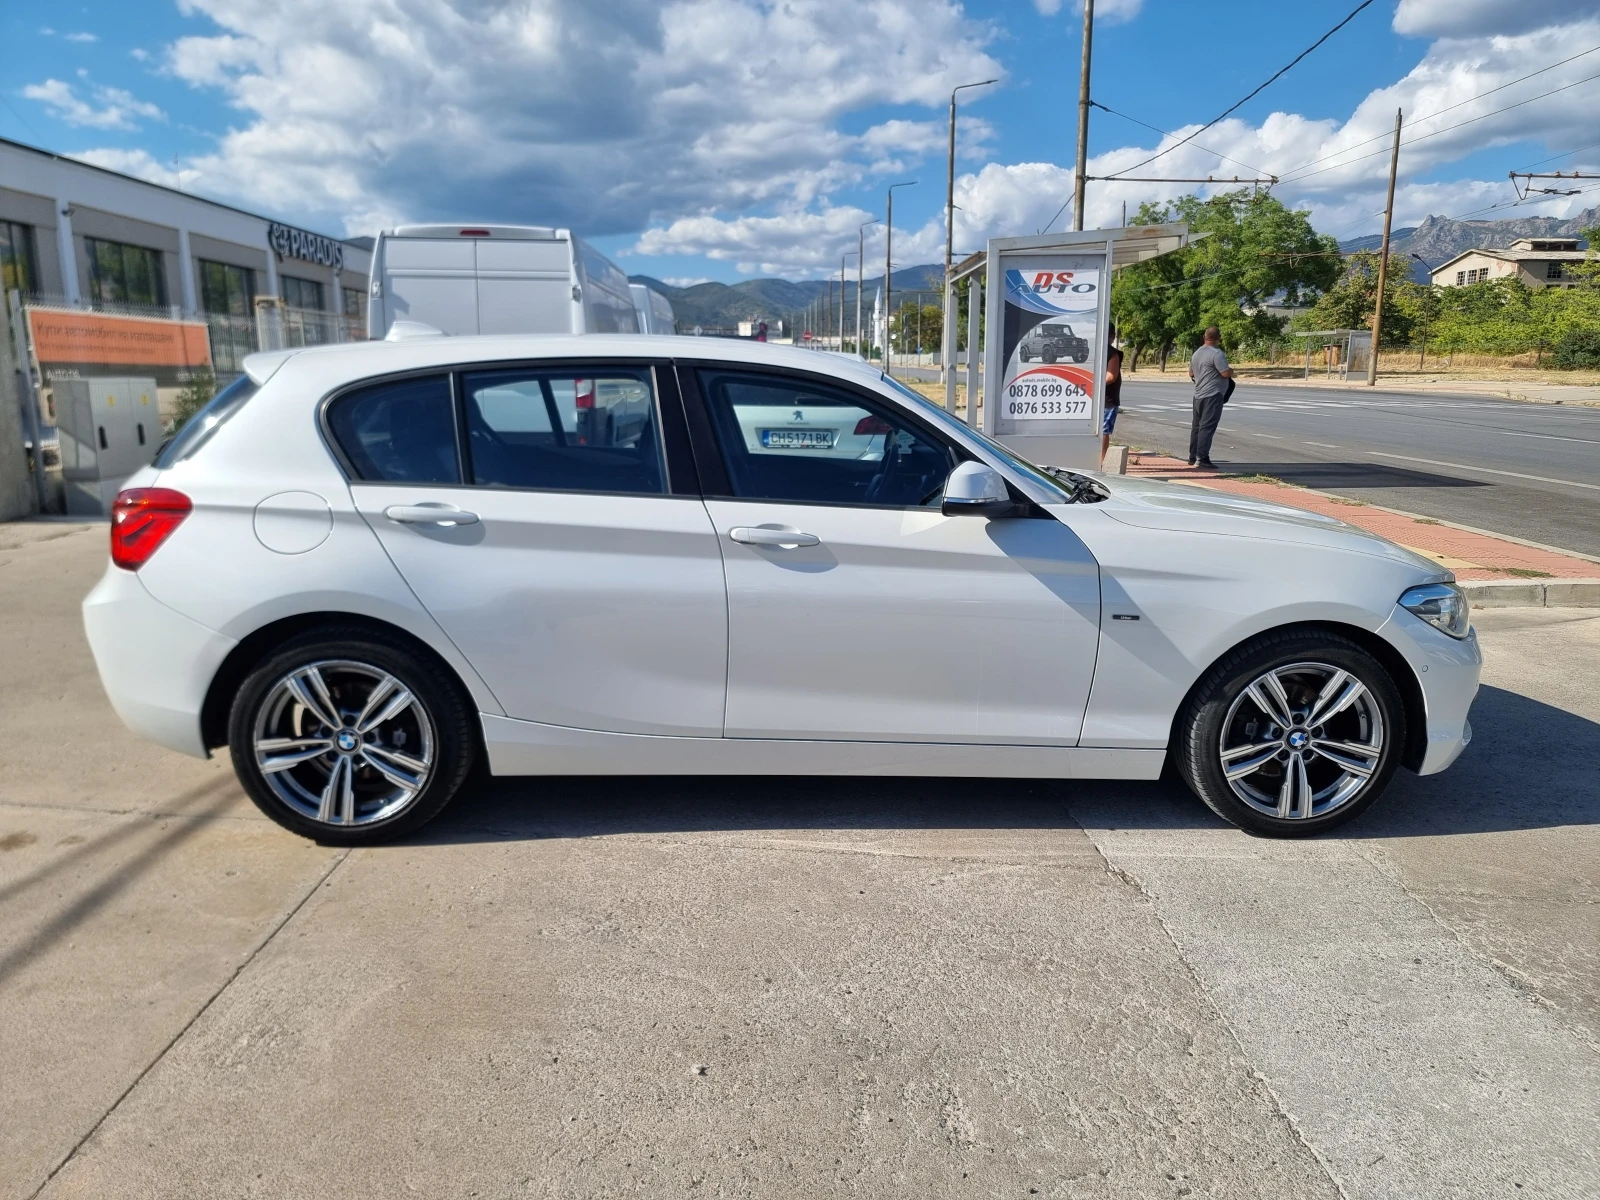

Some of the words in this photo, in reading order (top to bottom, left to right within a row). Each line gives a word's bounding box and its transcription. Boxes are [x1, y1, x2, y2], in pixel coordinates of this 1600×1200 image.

[291, 228, 343, 269] PARADIS
[1009, 283, 1097, 294] AUTO
[1009, 384, 1038, 397] 0878
[1041, 384, 1063, 397] 699
[1065, 384, 1087, 397] 645
[1009, 402, 1038, 414] 0876
[1041, 402, 1062, 414] 533
[1065, 401, 1087, 414] 577
